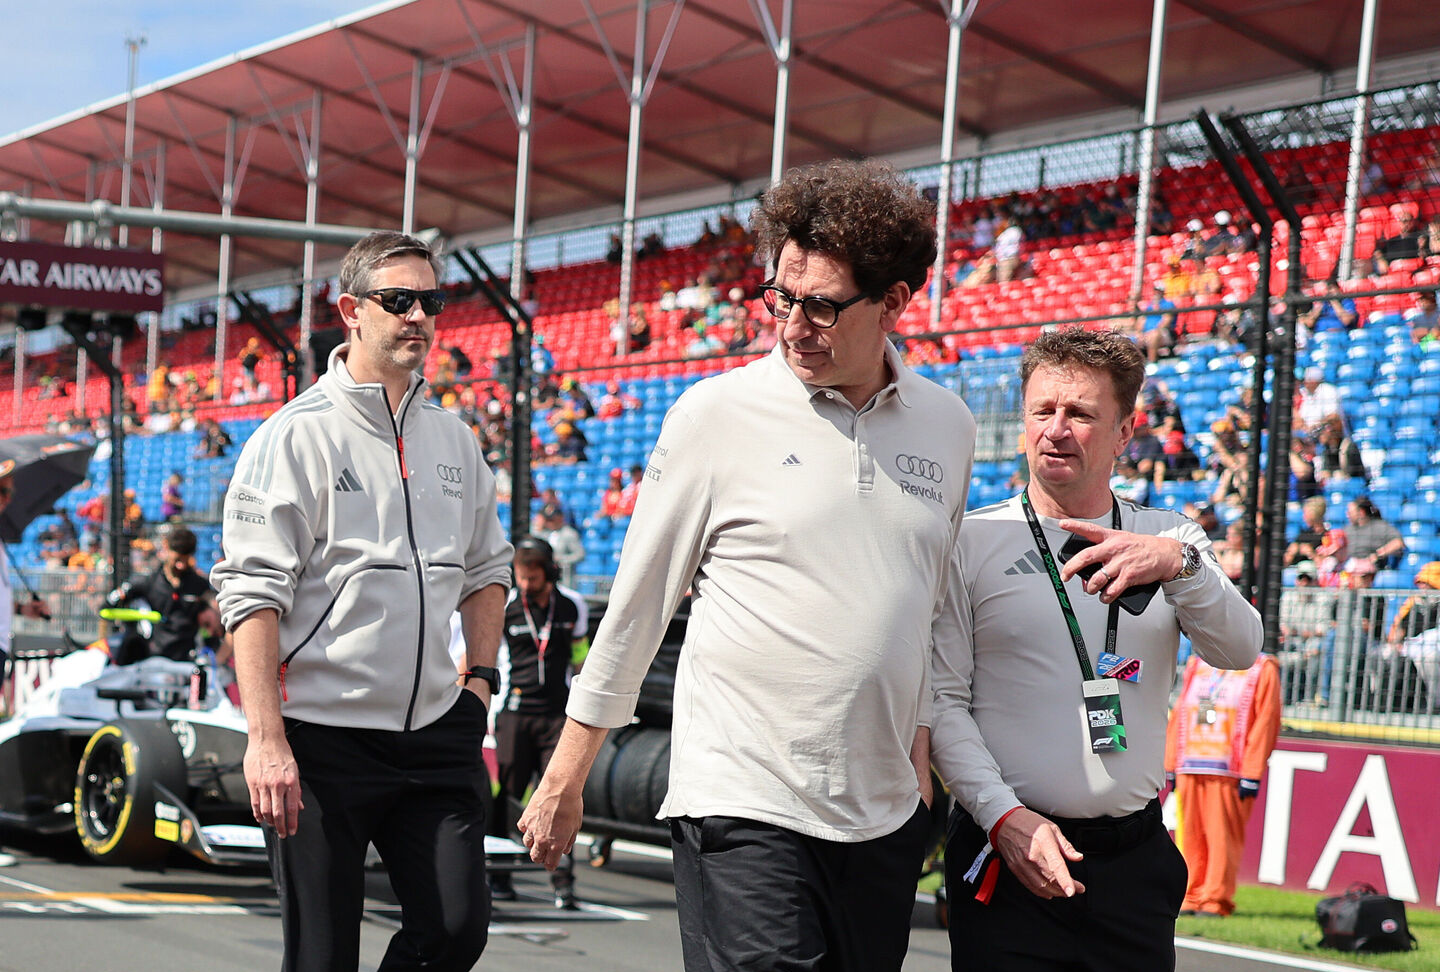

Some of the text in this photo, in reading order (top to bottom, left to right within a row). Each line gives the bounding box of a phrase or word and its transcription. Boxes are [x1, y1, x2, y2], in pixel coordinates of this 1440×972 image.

[44, 261, 163, 297] AIRWAYS
[900, 480, 945, 505] Revolut
[1044, 552, 1063, 590] PADDOCK
[1088, 708, 1117, 721] PDK
[1090, 719, 1118, 728] 2026
